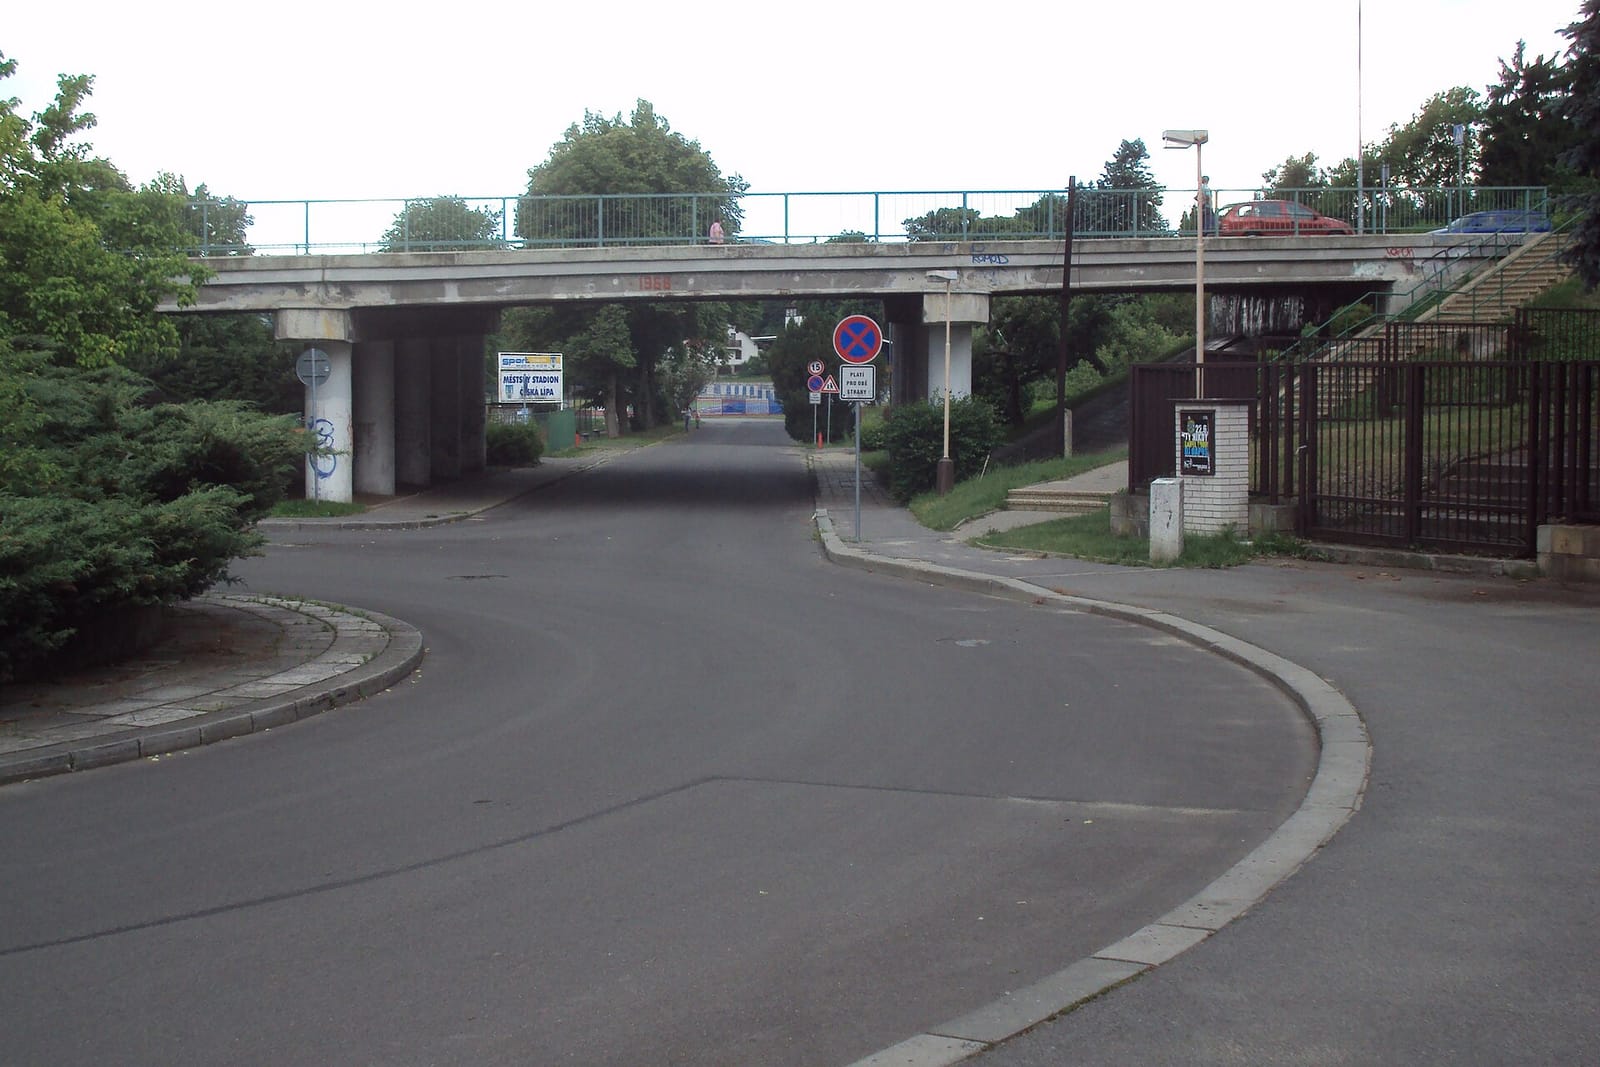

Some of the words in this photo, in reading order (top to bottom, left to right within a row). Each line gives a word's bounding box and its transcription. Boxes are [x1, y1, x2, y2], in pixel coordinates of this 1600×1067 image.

[502, 357, 529, 366] sport
[812, 363, 820, 371] 15
[532, 375, 559, 384] STADION
[520, 386, 539, 396] ČSKÁ
[540, 386, 554, 396] LÍPA
